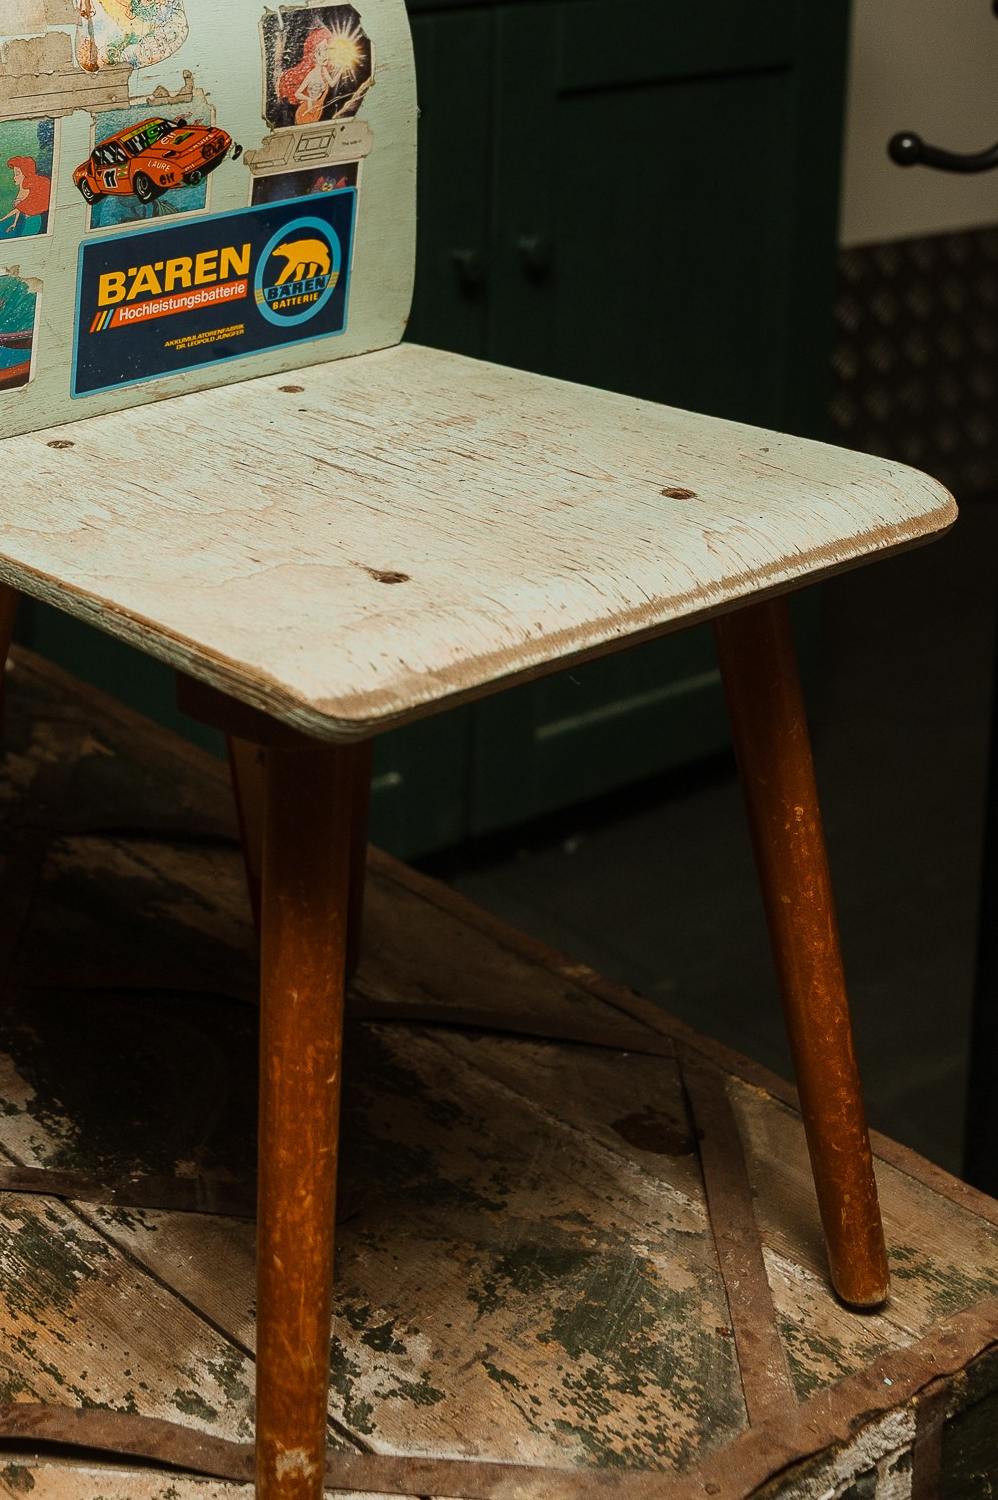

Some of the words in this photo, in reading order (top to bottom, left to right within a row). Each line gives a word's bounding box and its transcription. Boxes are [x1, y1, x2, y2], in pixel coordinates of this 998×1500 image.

[147, 160, 171, 172] LAURE
[159, 172, 176, 185] elf
[98, 243, 252, 307] BÄREN
[268, 276, 326, 300] BÄREN
[119, 282, 246, 321] Hochleistungsbatterie
[272, 292, 319, 311] BATTERIE
[164, 324, 245, 347] AKKUMULATORENFABRIK
[187, 336, 215, 348] LEOPOLD
[216, 329, 245, 341] JUNGFER
